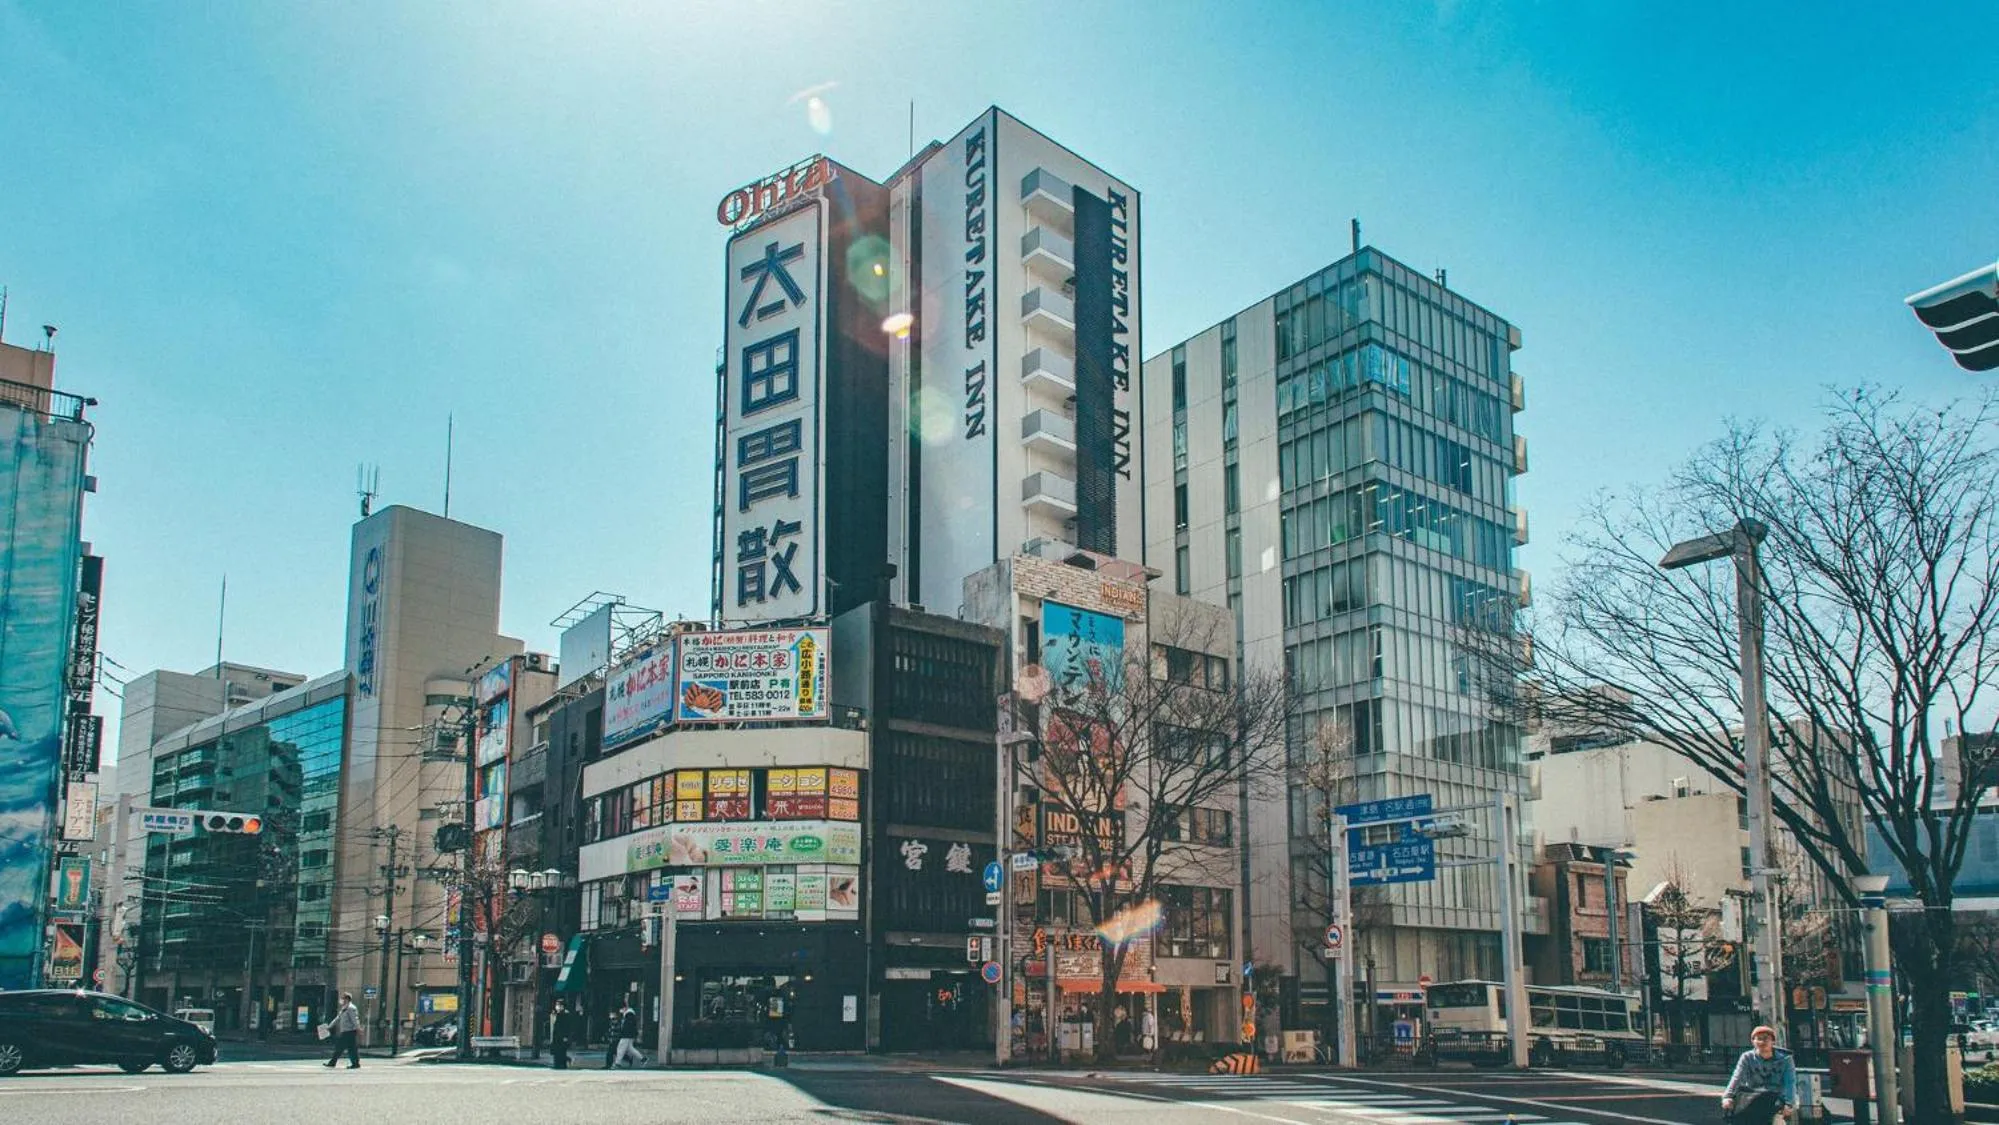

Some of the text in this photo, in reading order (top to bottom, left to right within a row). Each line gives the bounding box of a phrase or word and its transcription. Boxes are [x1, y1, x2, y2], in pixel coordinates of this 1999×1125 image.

[716, 155, 832, 228] Ohta
[964, 126, 986, 442] KURETAKE INN
[1107, 186, 1131, 480] KURETAKE INN
[737, 241, 808, 608] 太田胃散
